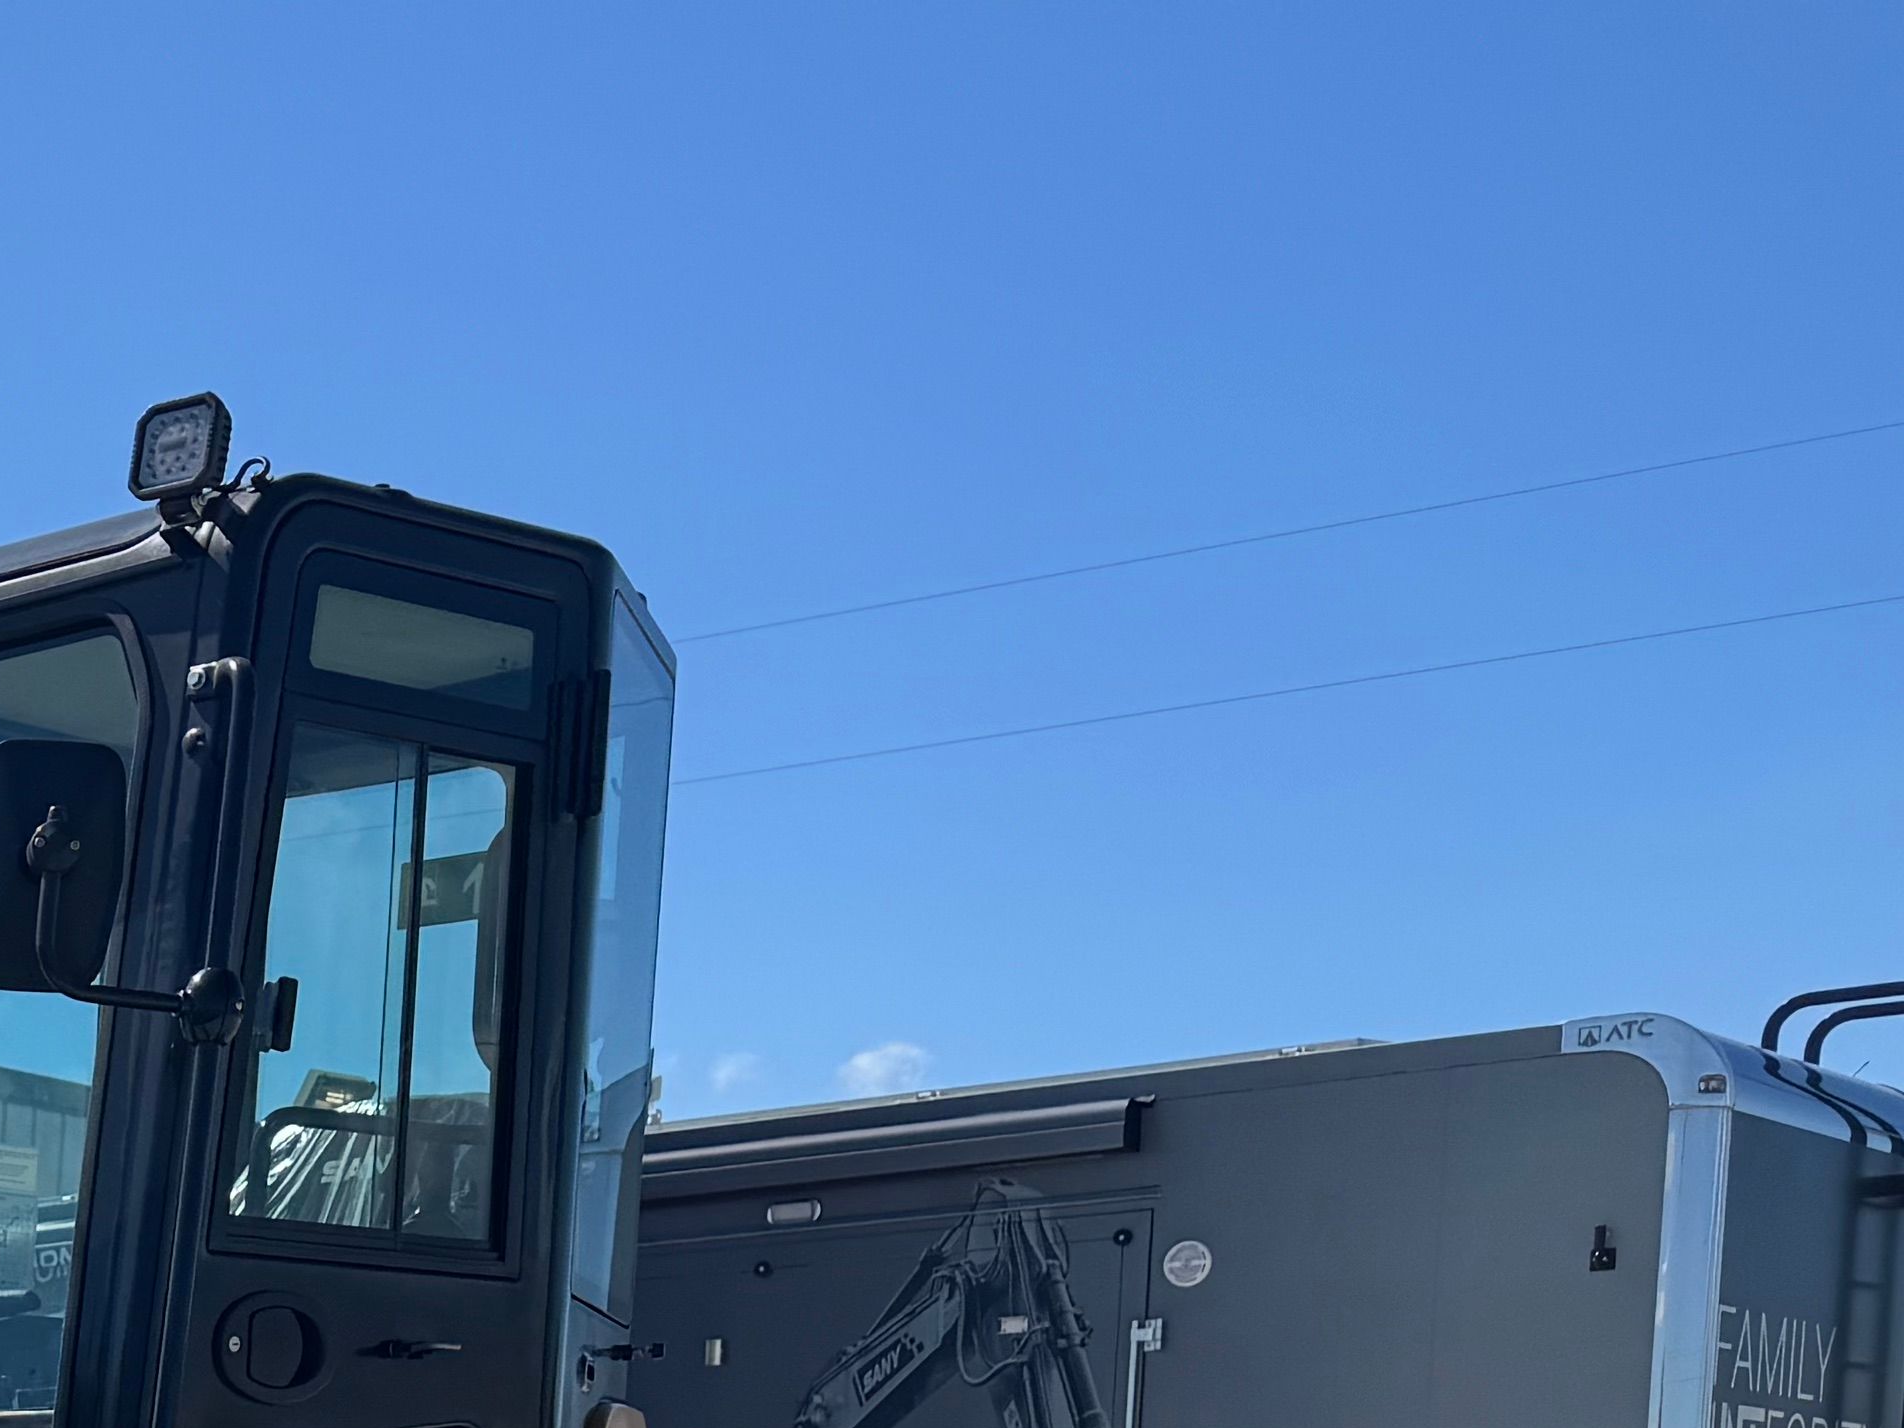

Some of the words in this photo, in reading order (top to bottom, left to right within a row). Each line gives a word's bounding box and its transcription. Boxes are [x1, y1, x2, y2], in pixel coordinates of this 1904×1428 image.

[1605, 1018, 1655, 1042] ATC
[863, 1343, 902, 1394] SANY
[1716, 1304, 1838, 1403] FAMILY
